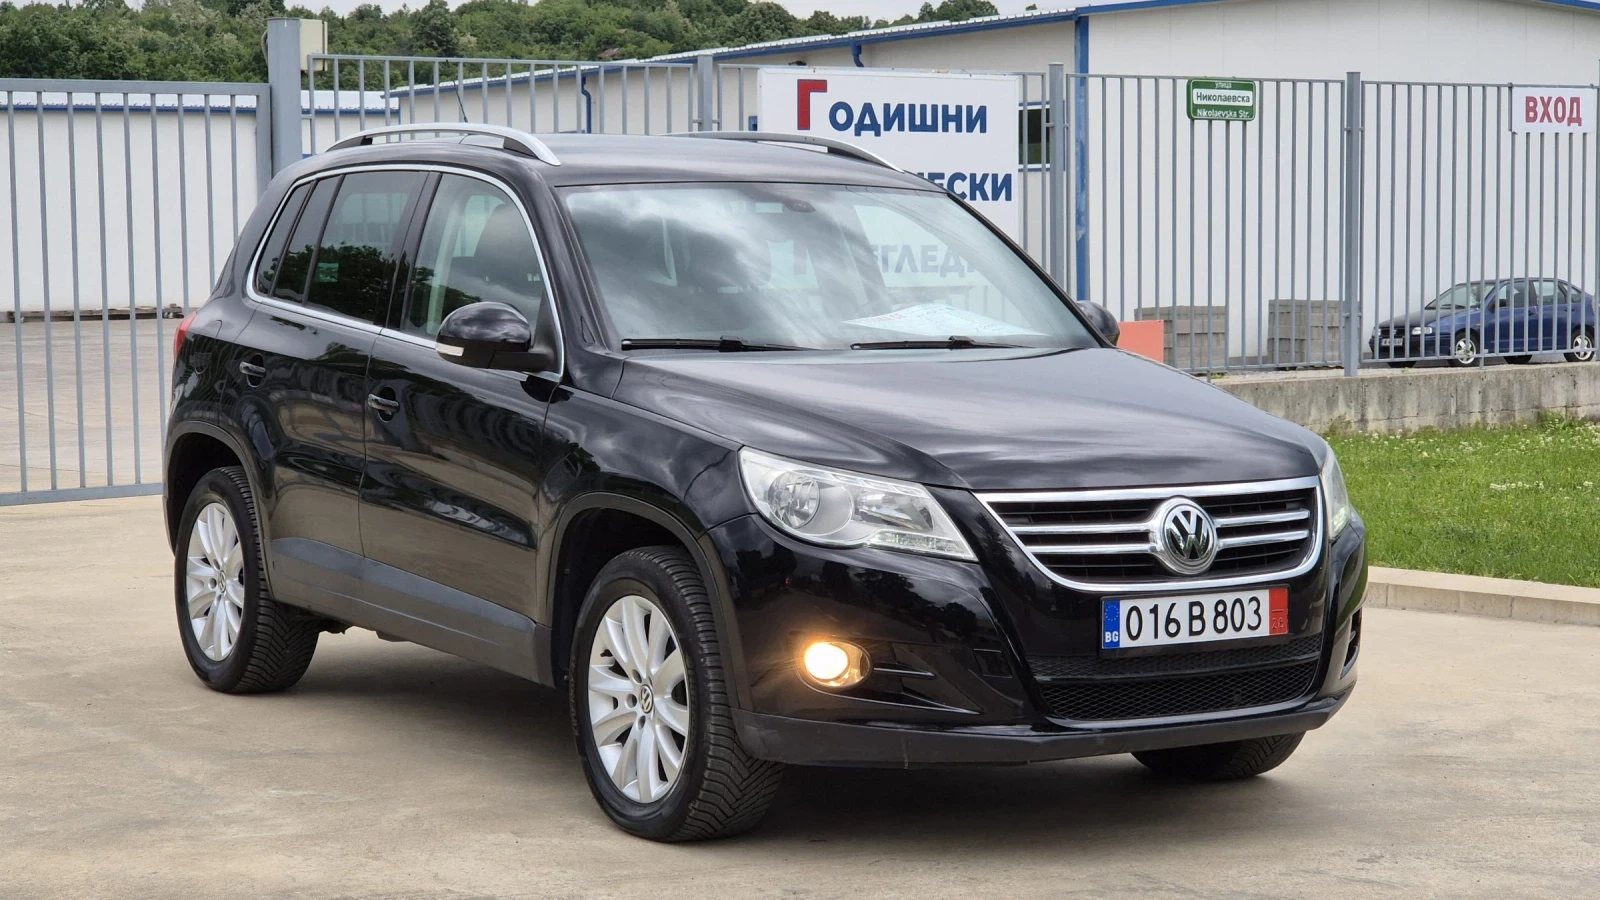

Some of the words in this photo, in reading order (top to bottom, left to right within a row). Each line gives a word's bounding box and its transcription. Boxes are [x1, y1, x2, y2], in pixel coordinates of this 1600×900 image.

[1196, 91, 1250, 103] Николаевска
[797, 79, 987, 137] ГОДИШНИ
[1197, 109, 1237, 118] Nikolaevska
[1238, 110, 1250, 118] Str.
[1525, 96, 1582, 127] ВХОД
[917, 172, 1012, 201] СКИ
[1105, 631, 1119, 643] BG
